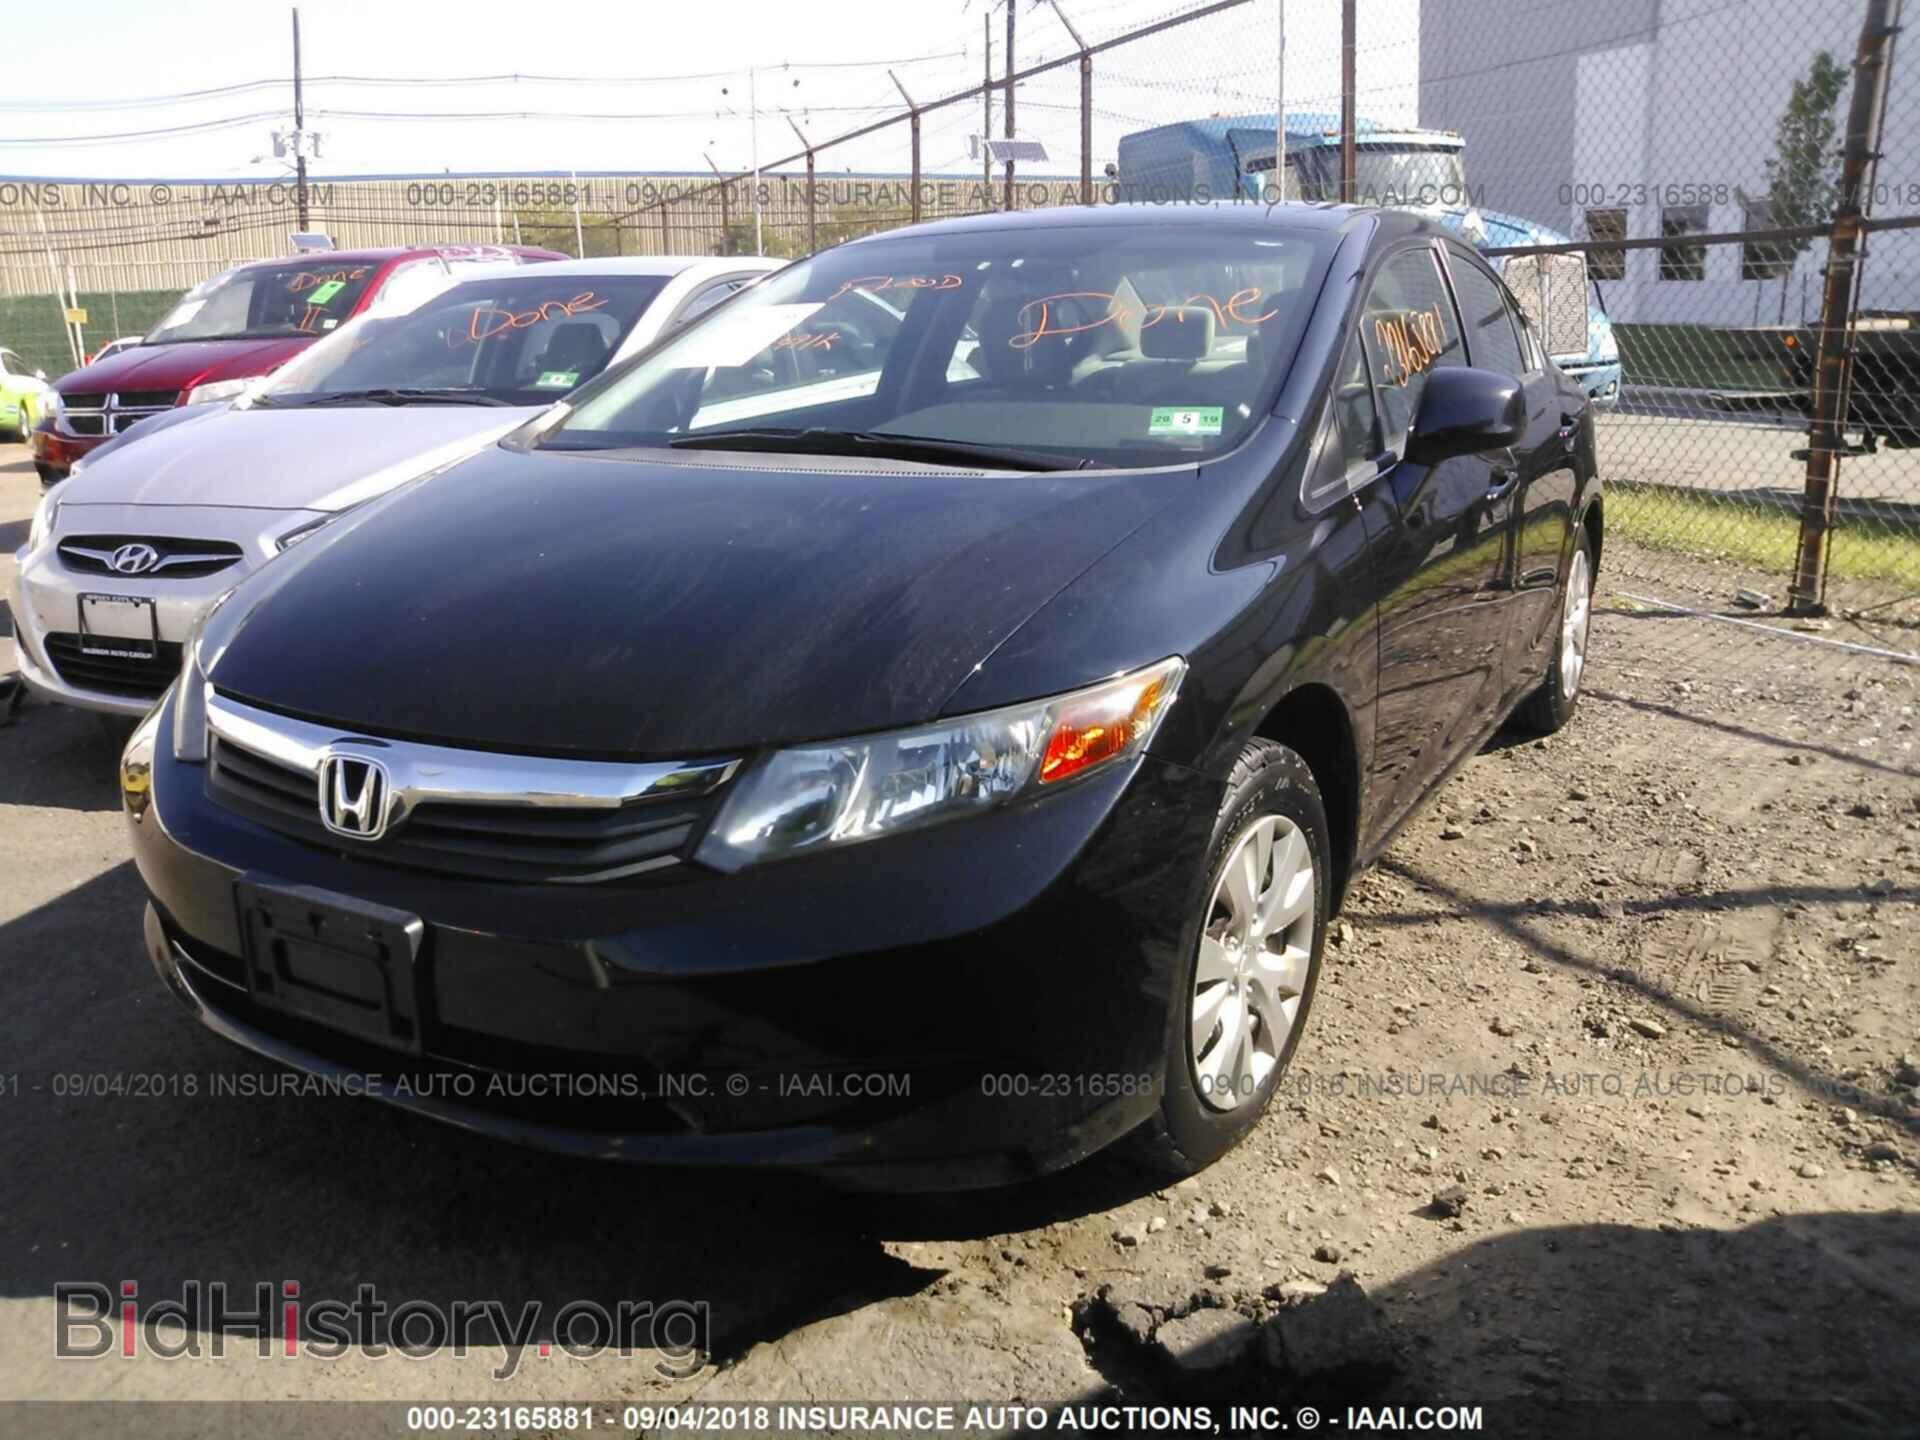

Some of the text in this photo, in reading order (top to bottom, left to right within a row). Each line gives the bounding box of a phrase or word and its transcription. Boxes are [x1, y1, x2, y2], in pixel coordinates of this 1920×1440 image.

[471, 292, 608, 340] Done
[1009, 287, 1279, 349] Done
[1182, 412, 1192, 425] 5
